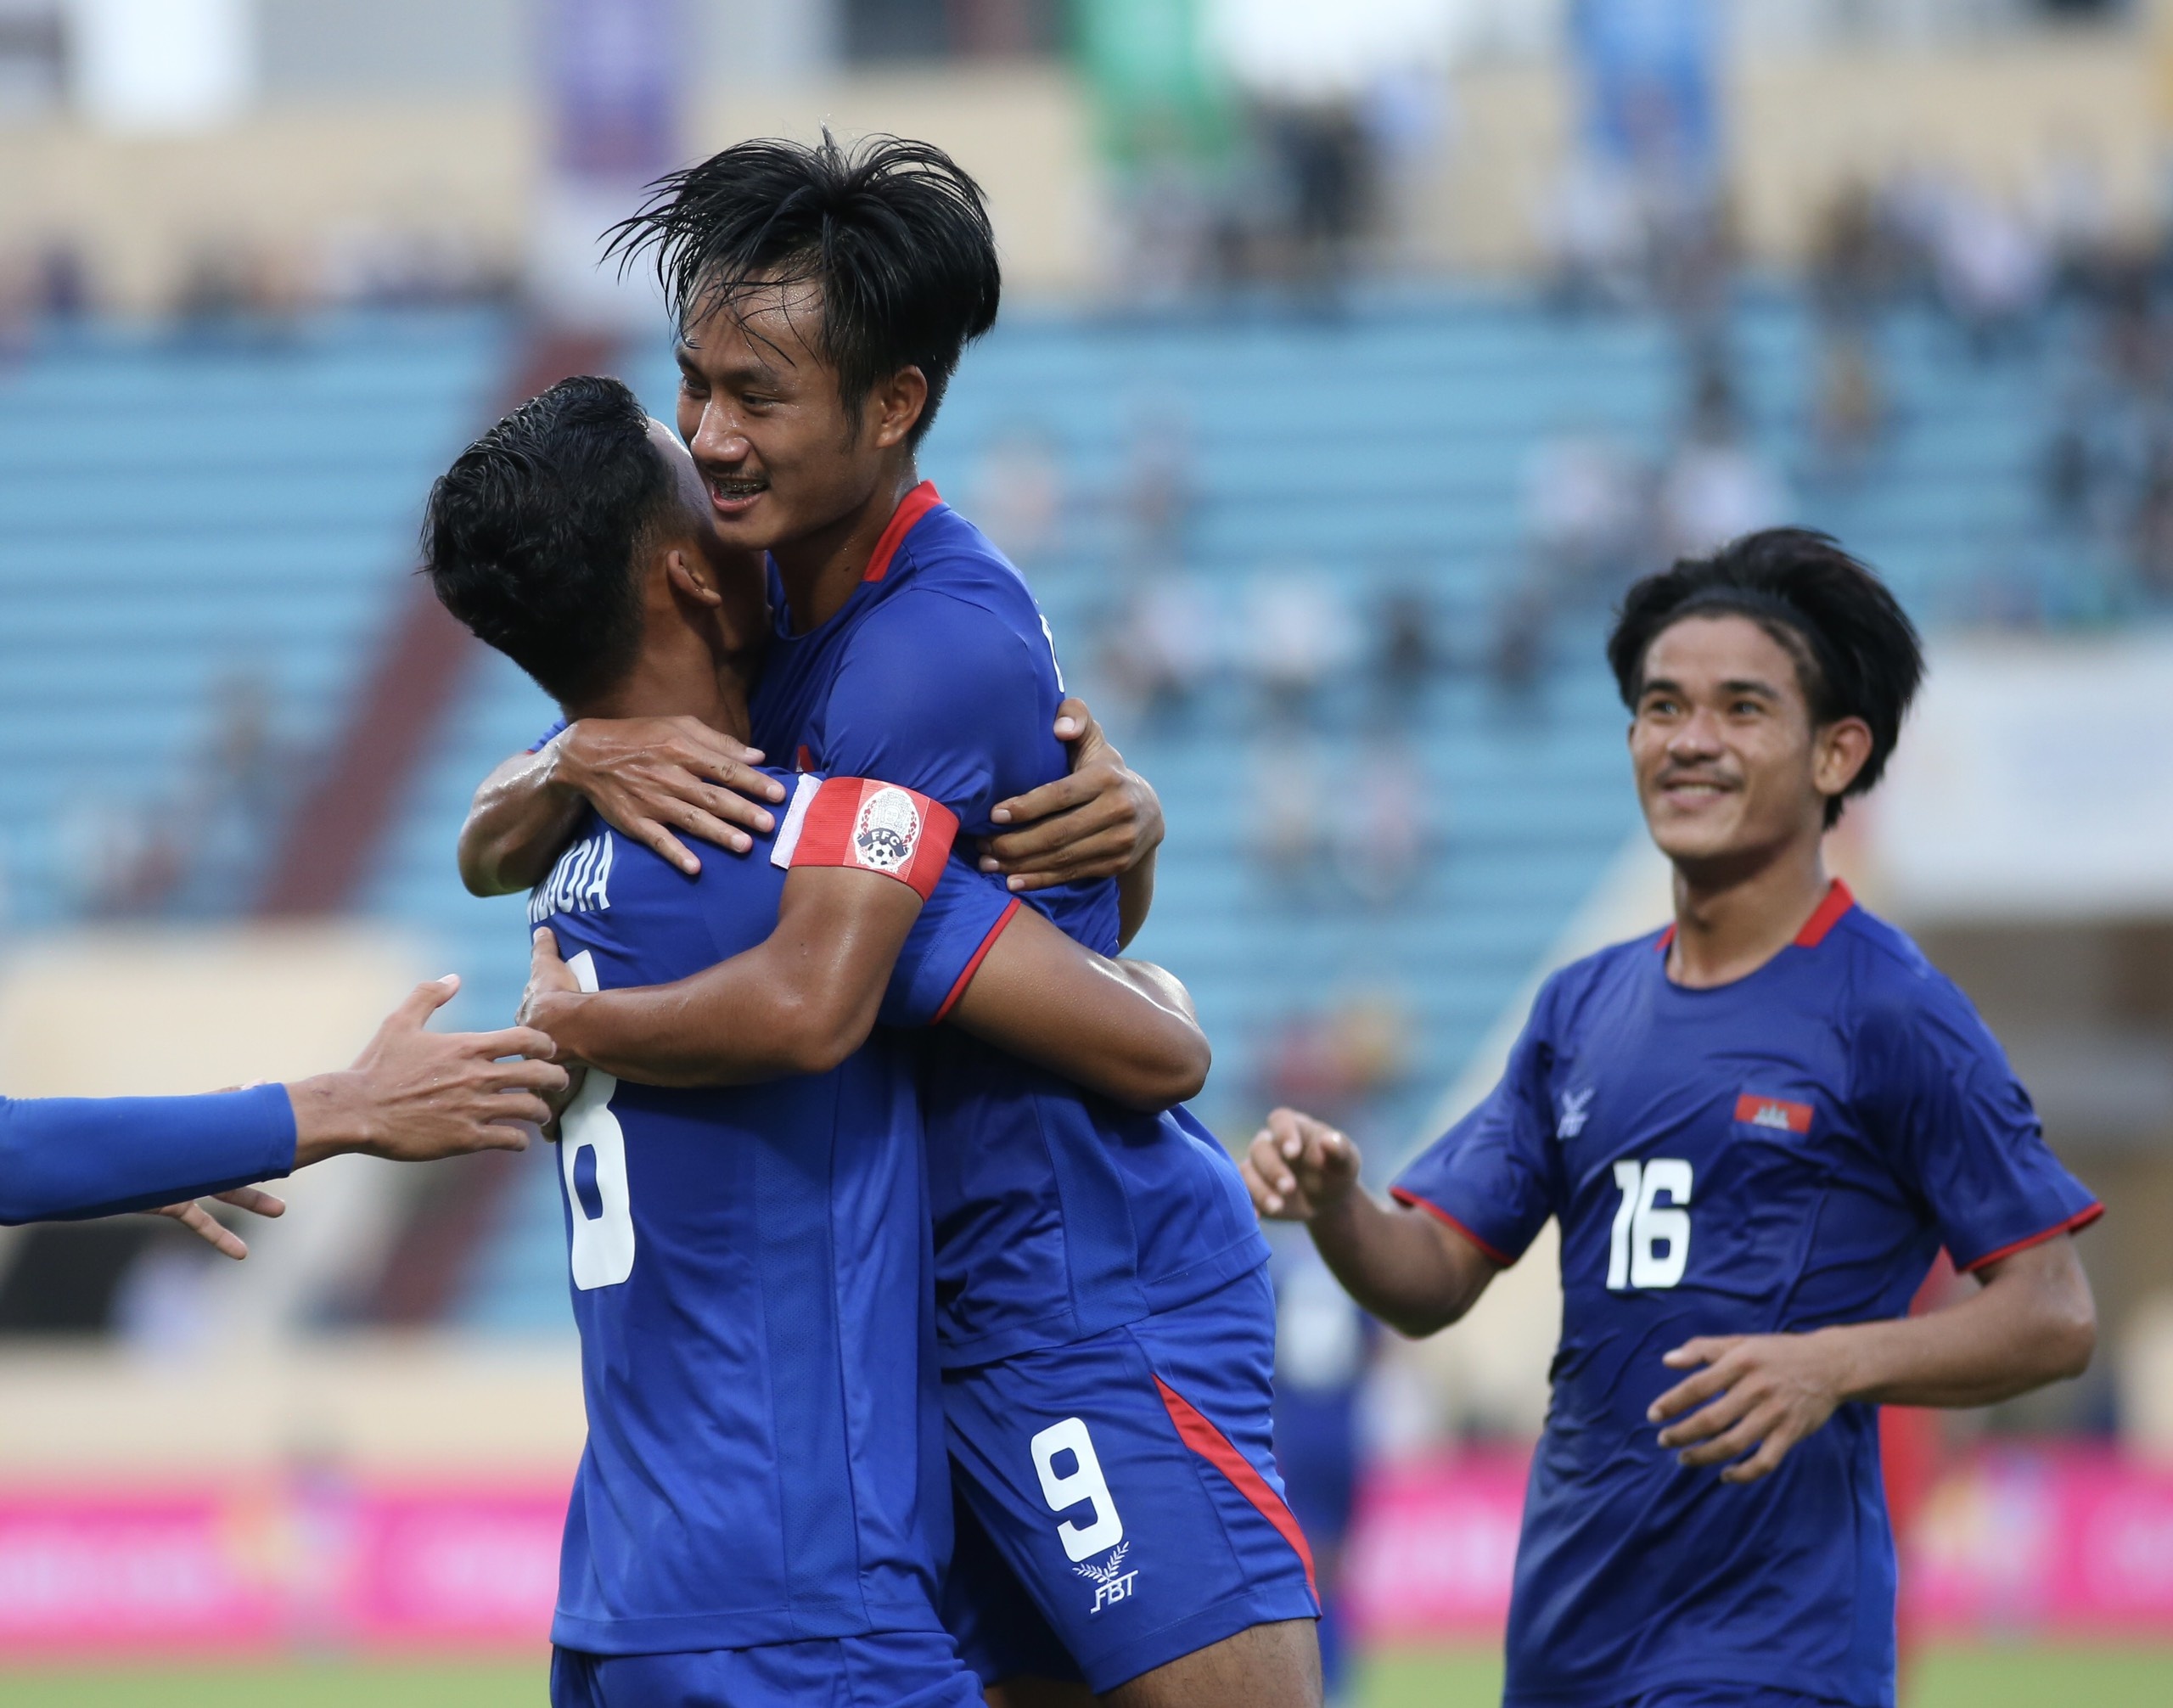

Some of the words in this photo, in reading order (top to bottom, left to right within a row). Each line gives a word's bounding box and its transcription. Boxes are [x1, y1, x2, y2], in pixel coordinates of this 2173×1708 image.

[871, 830, 901, 846] FFC
[1606, 1158, 1694, 1289] 16
[1030, 1417, 1124, 1563] 9
[1090, 1570, 1139, 1615] FBT
